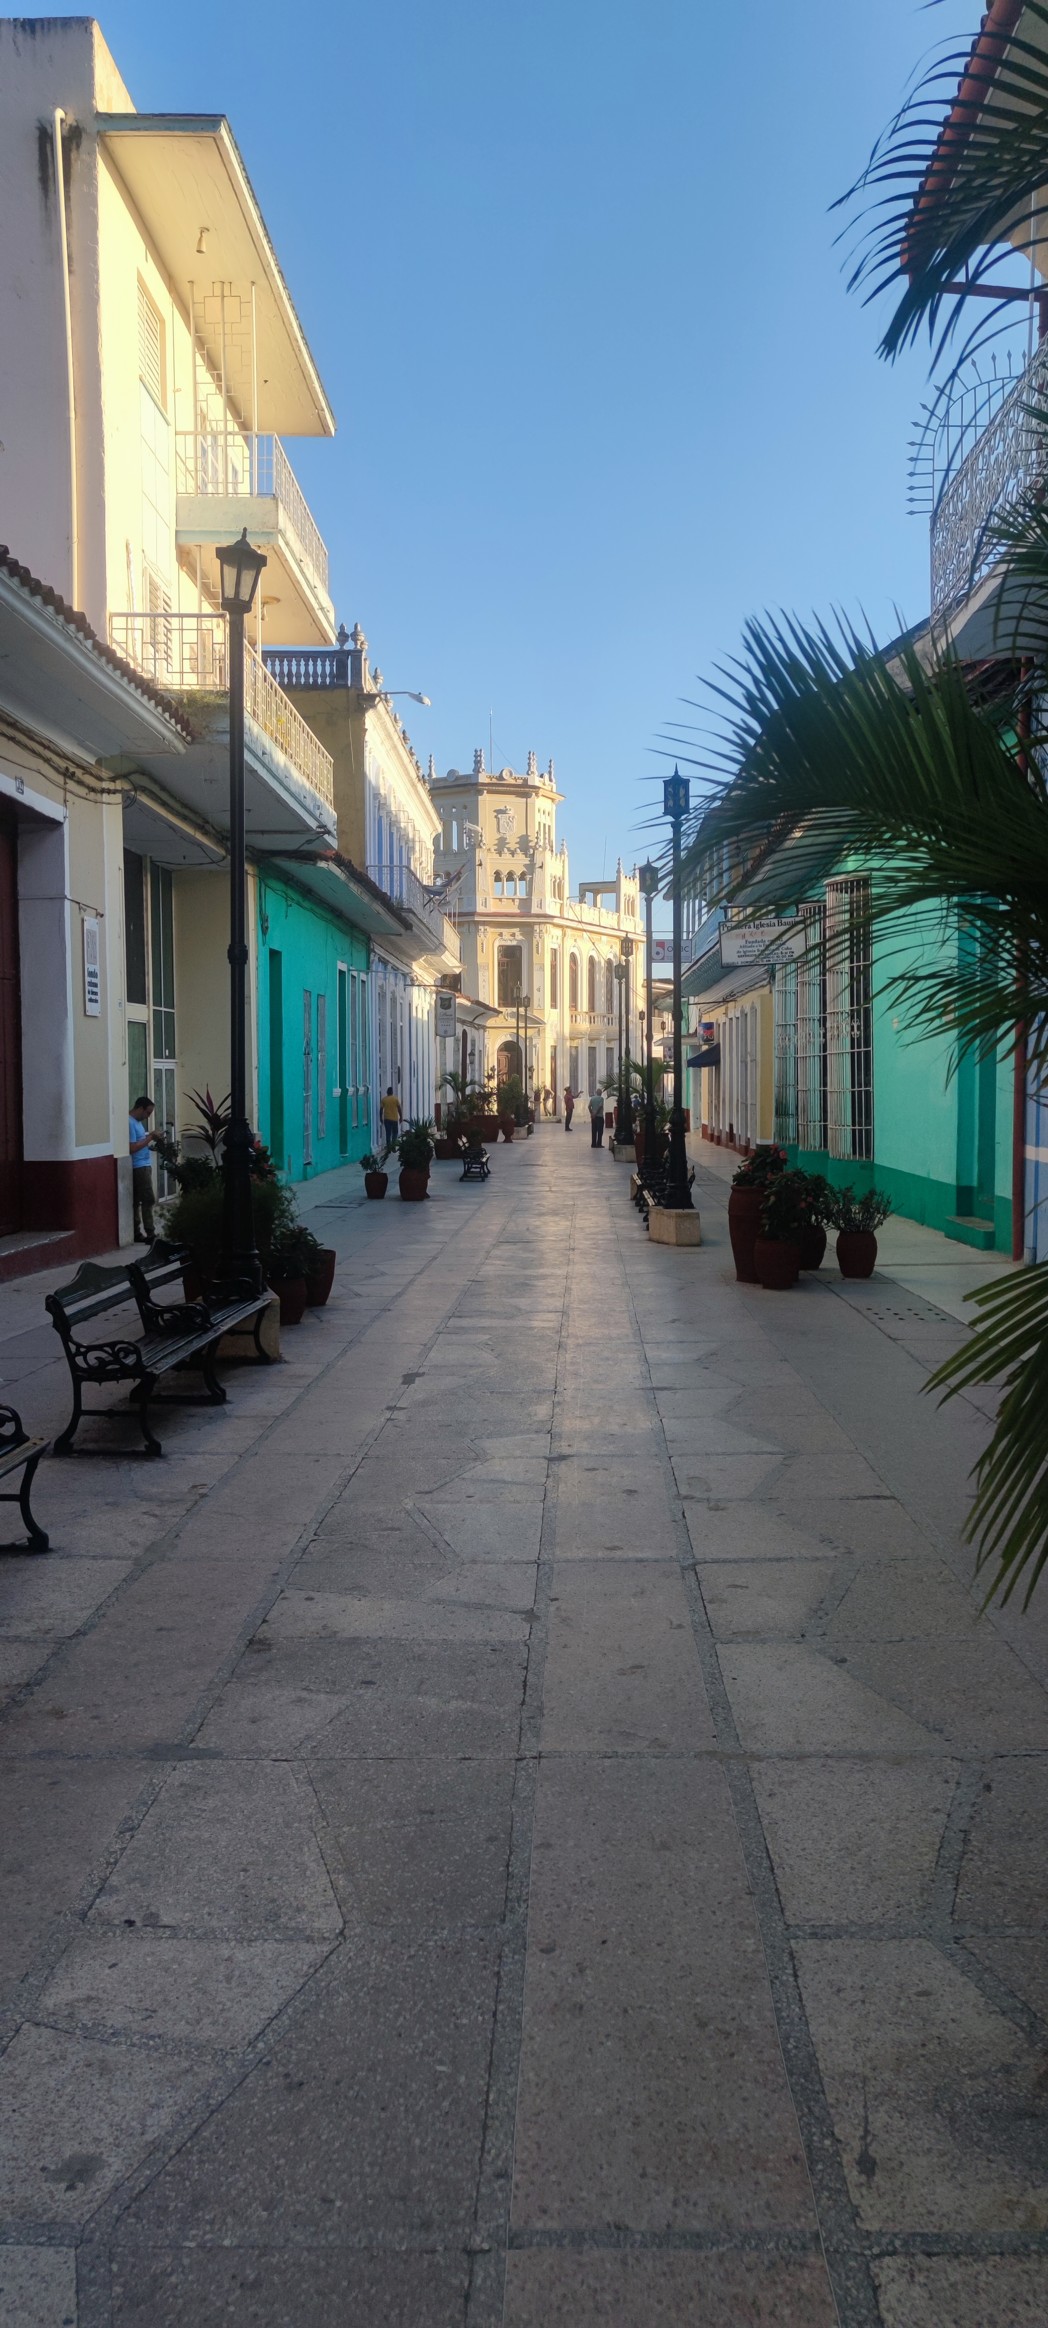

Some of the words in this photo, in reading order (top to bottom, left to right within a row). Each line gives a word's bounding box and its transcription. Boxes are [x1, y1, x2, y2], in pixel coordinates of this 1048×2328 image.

[722, 923, 752, 932] Priera
[753, 920, 776, 930] Iglesia
[777, 918, 802, 928] Bauti
